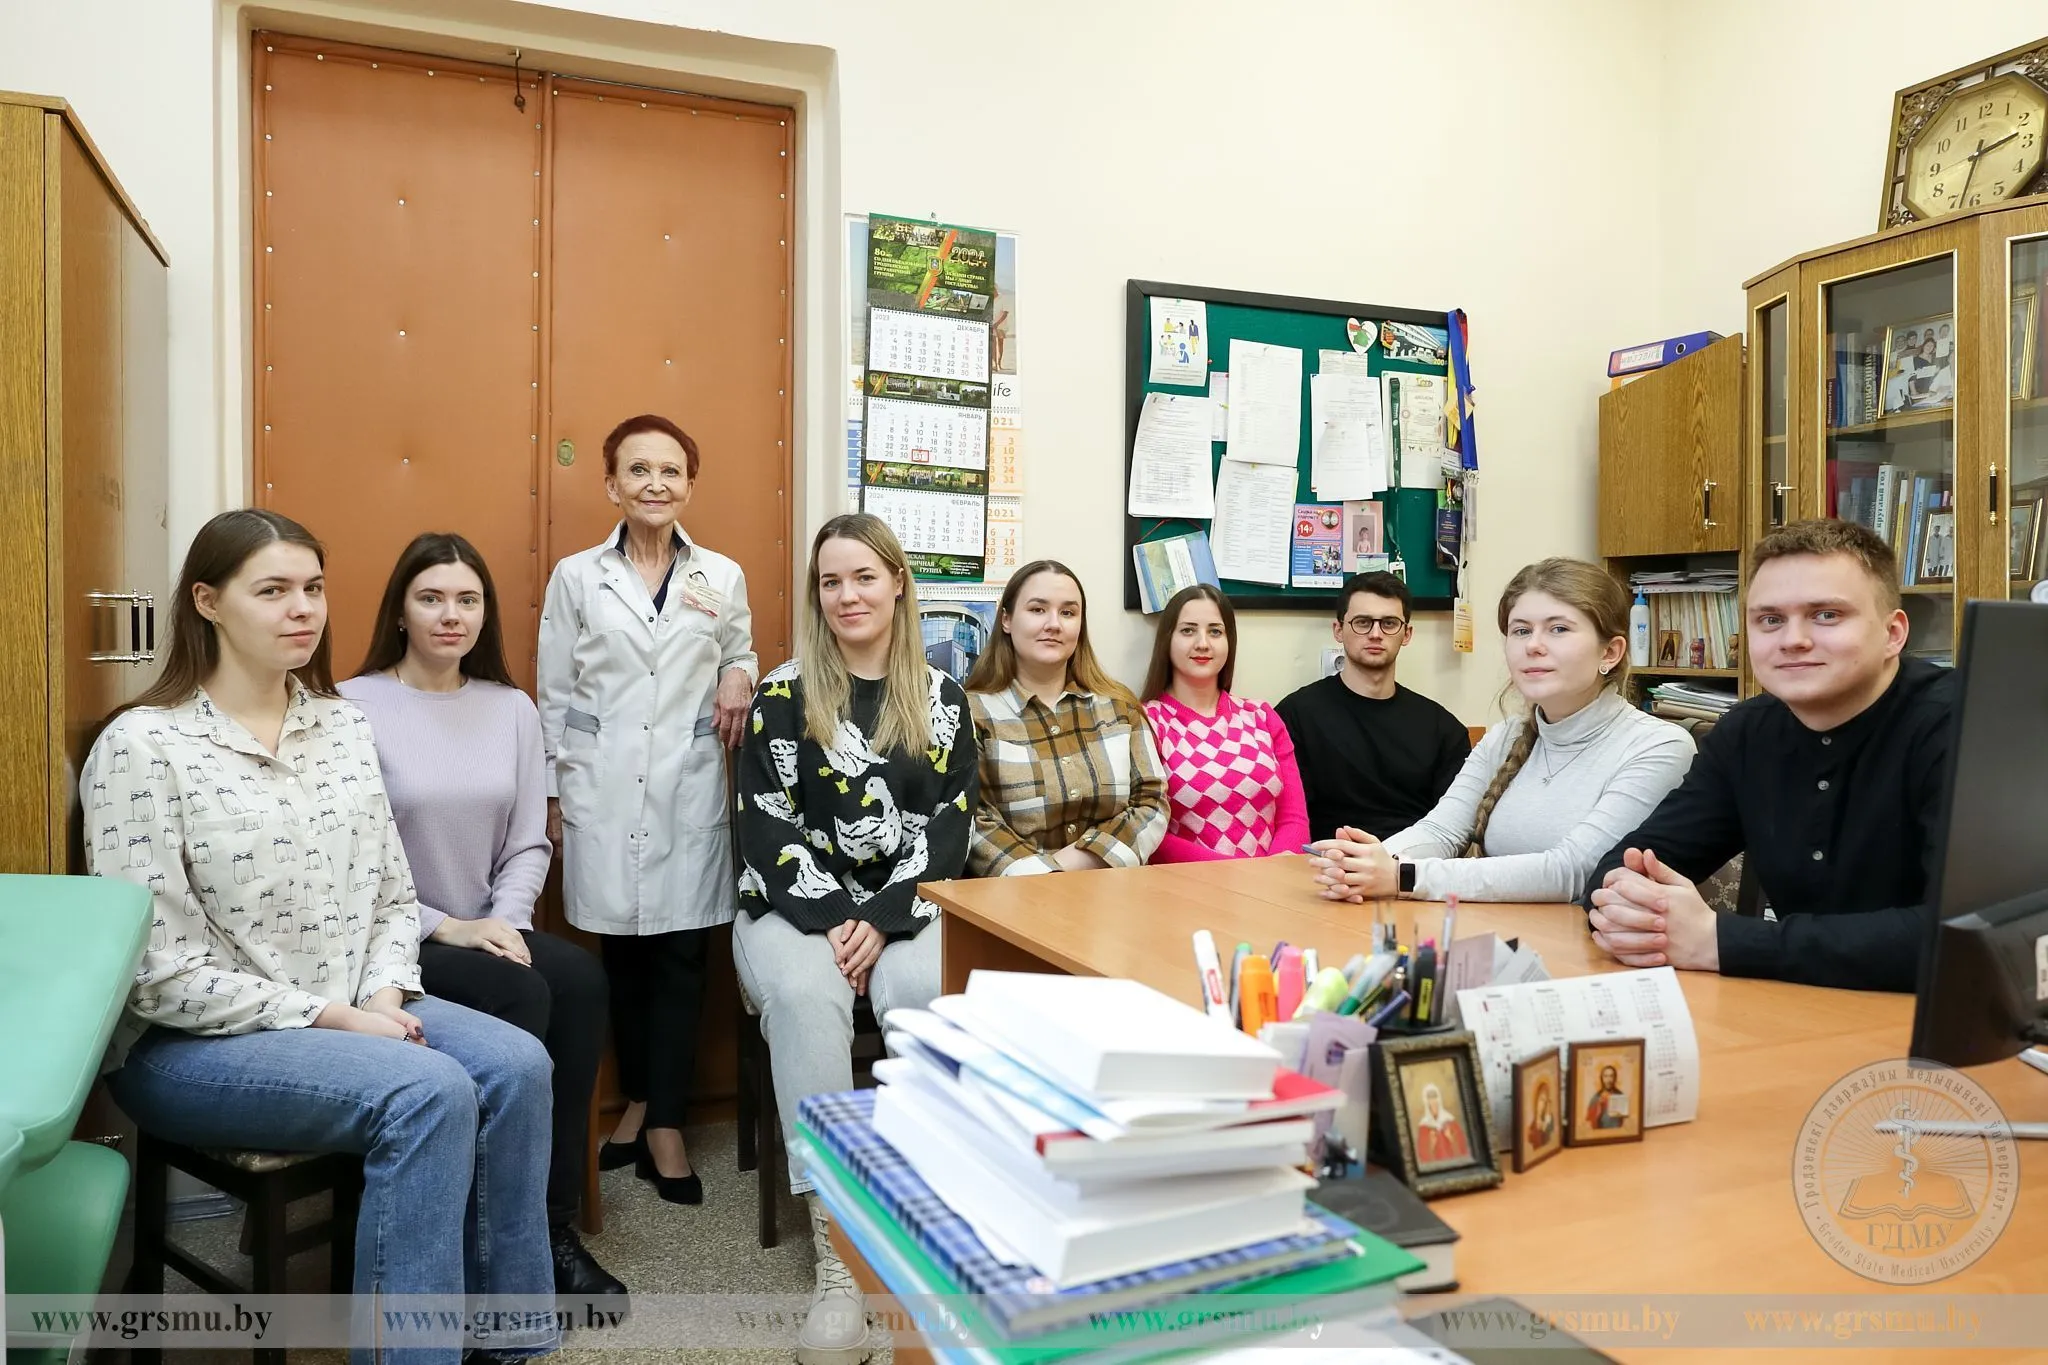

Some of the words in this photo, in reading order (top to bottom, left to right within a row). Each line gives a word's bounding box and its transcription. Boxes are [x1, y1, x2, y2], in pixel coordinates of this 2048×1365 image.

[1978, 102, 1993, 119] 12
[2005, 103, 2010, 115] 1
[1956, 117, 1967, 132] 11
[2018, 112, 2030, 129] 2
[1937, 138, 1950, 154] 10
[2022, 134, 2033, 148] 3
[1930, 163, 1941, 177] 9
[2013, 159, 2024, 173] 4
[1933, 183, 1944, 198] 8
[1993, 181, 2004, 196] 5
[1948, 195, 1959, 209] 7
[1969, 193, 1981, 207] 6
[874, 248, 885, 257] 80
[957, 325, 985, 334] ДЕКАБРЬ
[993, 382, 1011, 397] ife
[993, 417, 1014, 426] 021
[1009, 437, 1014, 445] 3
[1003, 466, 1014, 474] 24
[951, 499, 980, 507] ФЕВРАЛЬ
[1876, 488, 1885, 528] круглый
[987, 509, 1015, 517] 2021
[990, 528, 996, 536] 6
[1009, 528, 1015, 536] 7
[1004, 558, 1015, 566] 28
